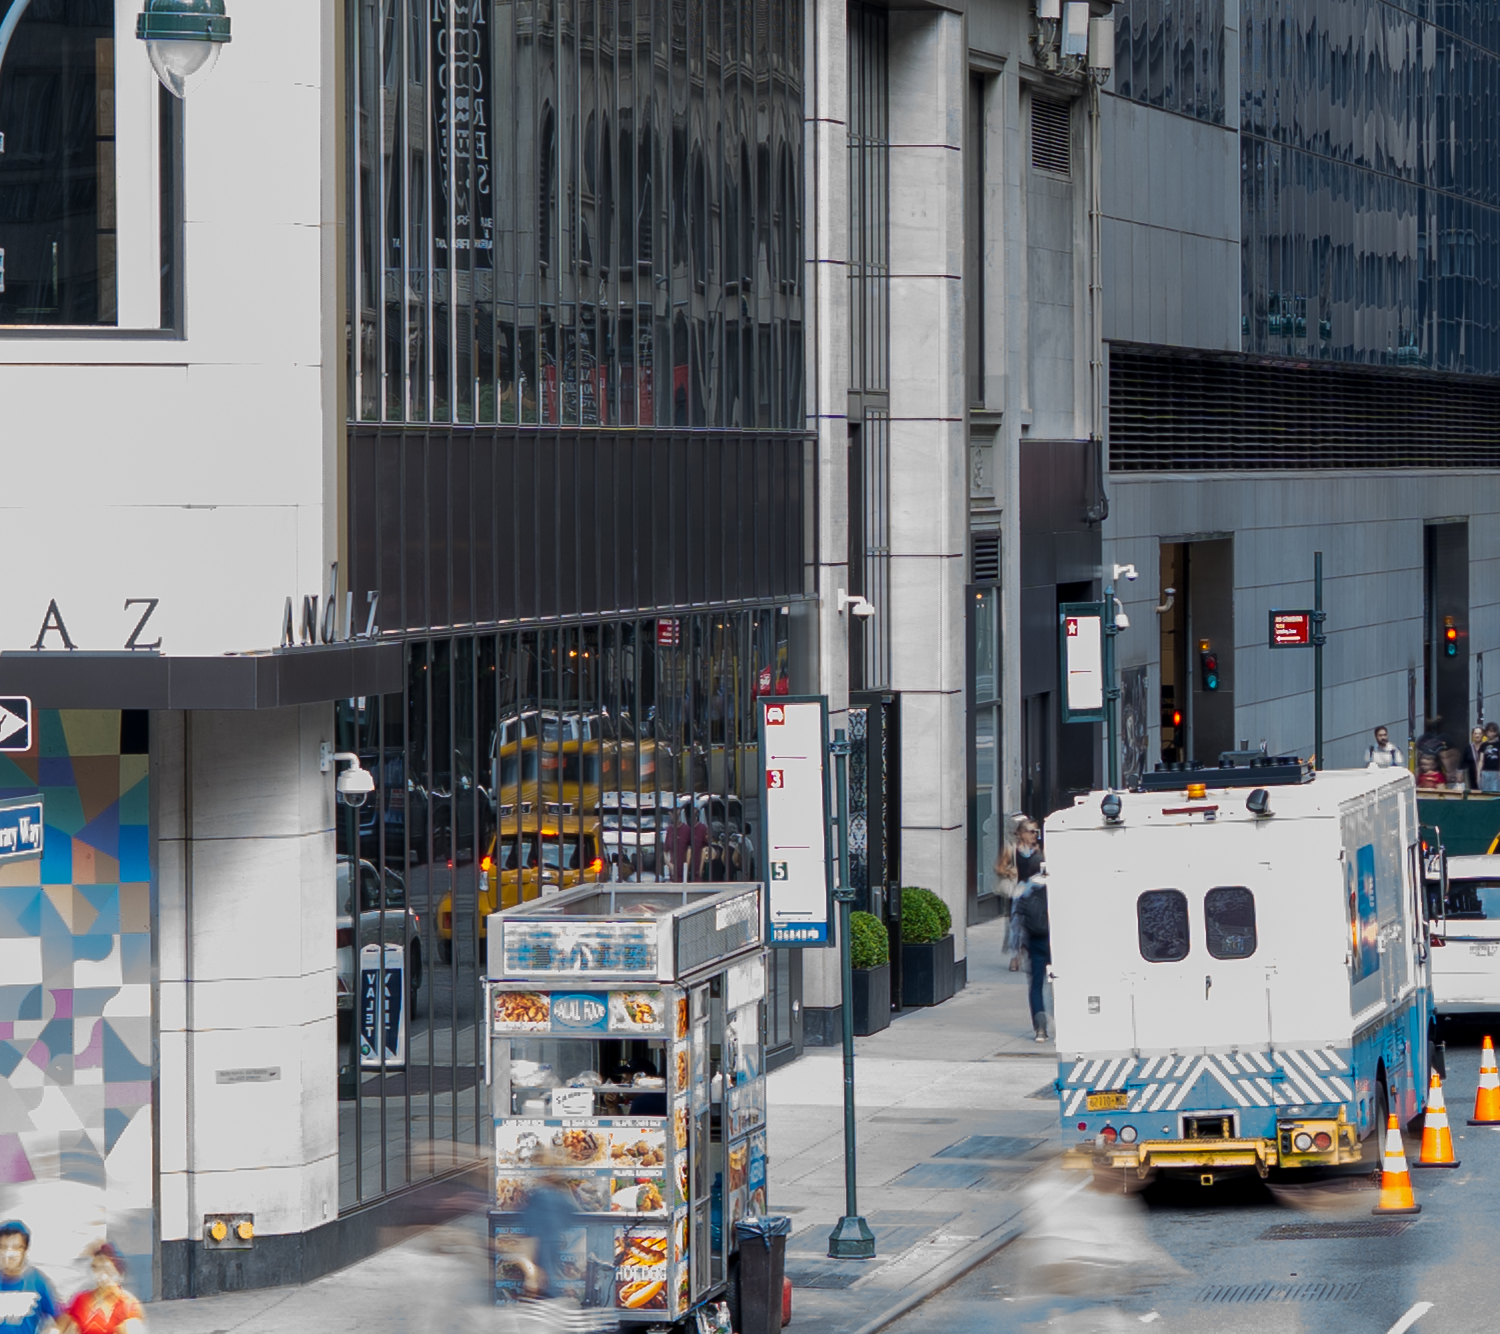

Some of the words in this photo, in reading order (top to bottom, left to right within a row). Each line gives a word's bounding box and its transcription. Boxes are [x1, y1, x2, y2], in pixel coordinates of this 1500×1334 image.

[770, 770, 781, 788] 3
[19, 817, 41, 845] Way
[775, 862, 785, 879] 5
